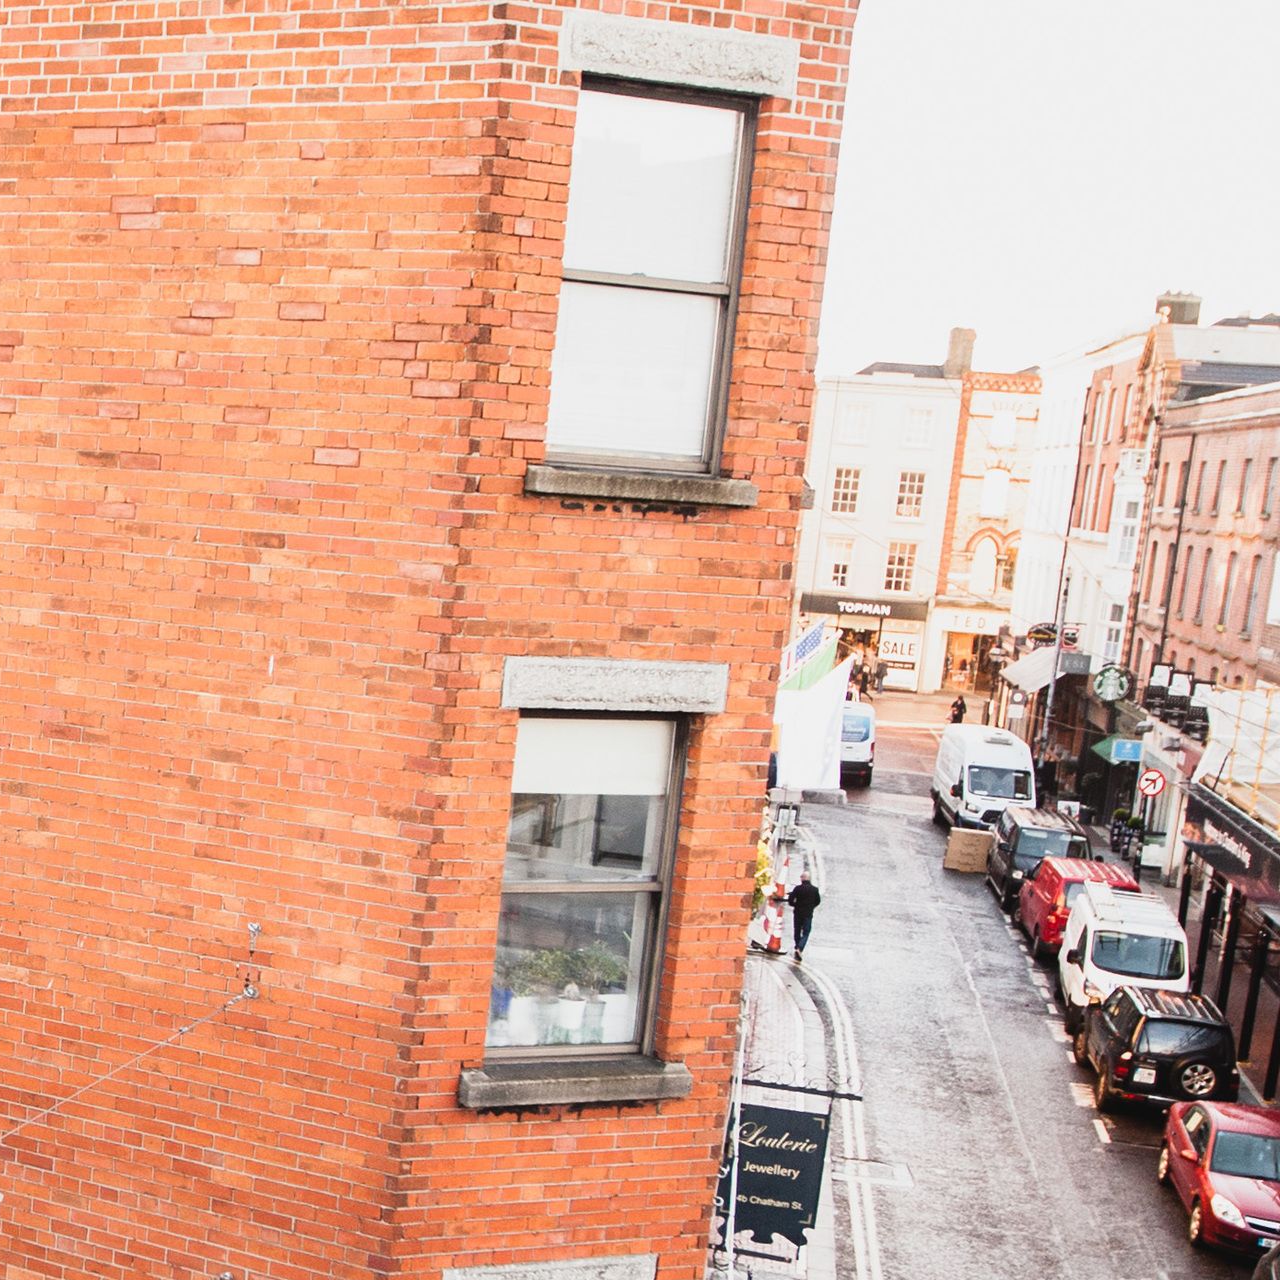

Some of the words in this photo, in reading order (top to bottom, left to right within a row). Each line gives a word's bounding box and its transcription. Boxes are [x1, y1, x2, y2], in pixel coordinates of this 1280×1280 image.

[838, 602, 891, 615] TOPMAN
[954, 615, 986, 629] TED
[883, 641, 916, 656] SALE
[738, 1122, 817, 1153] Loulerie
[743, 1161, 800, 1180] Jewellery
[749, 1196, 790, 1209] Chatham
